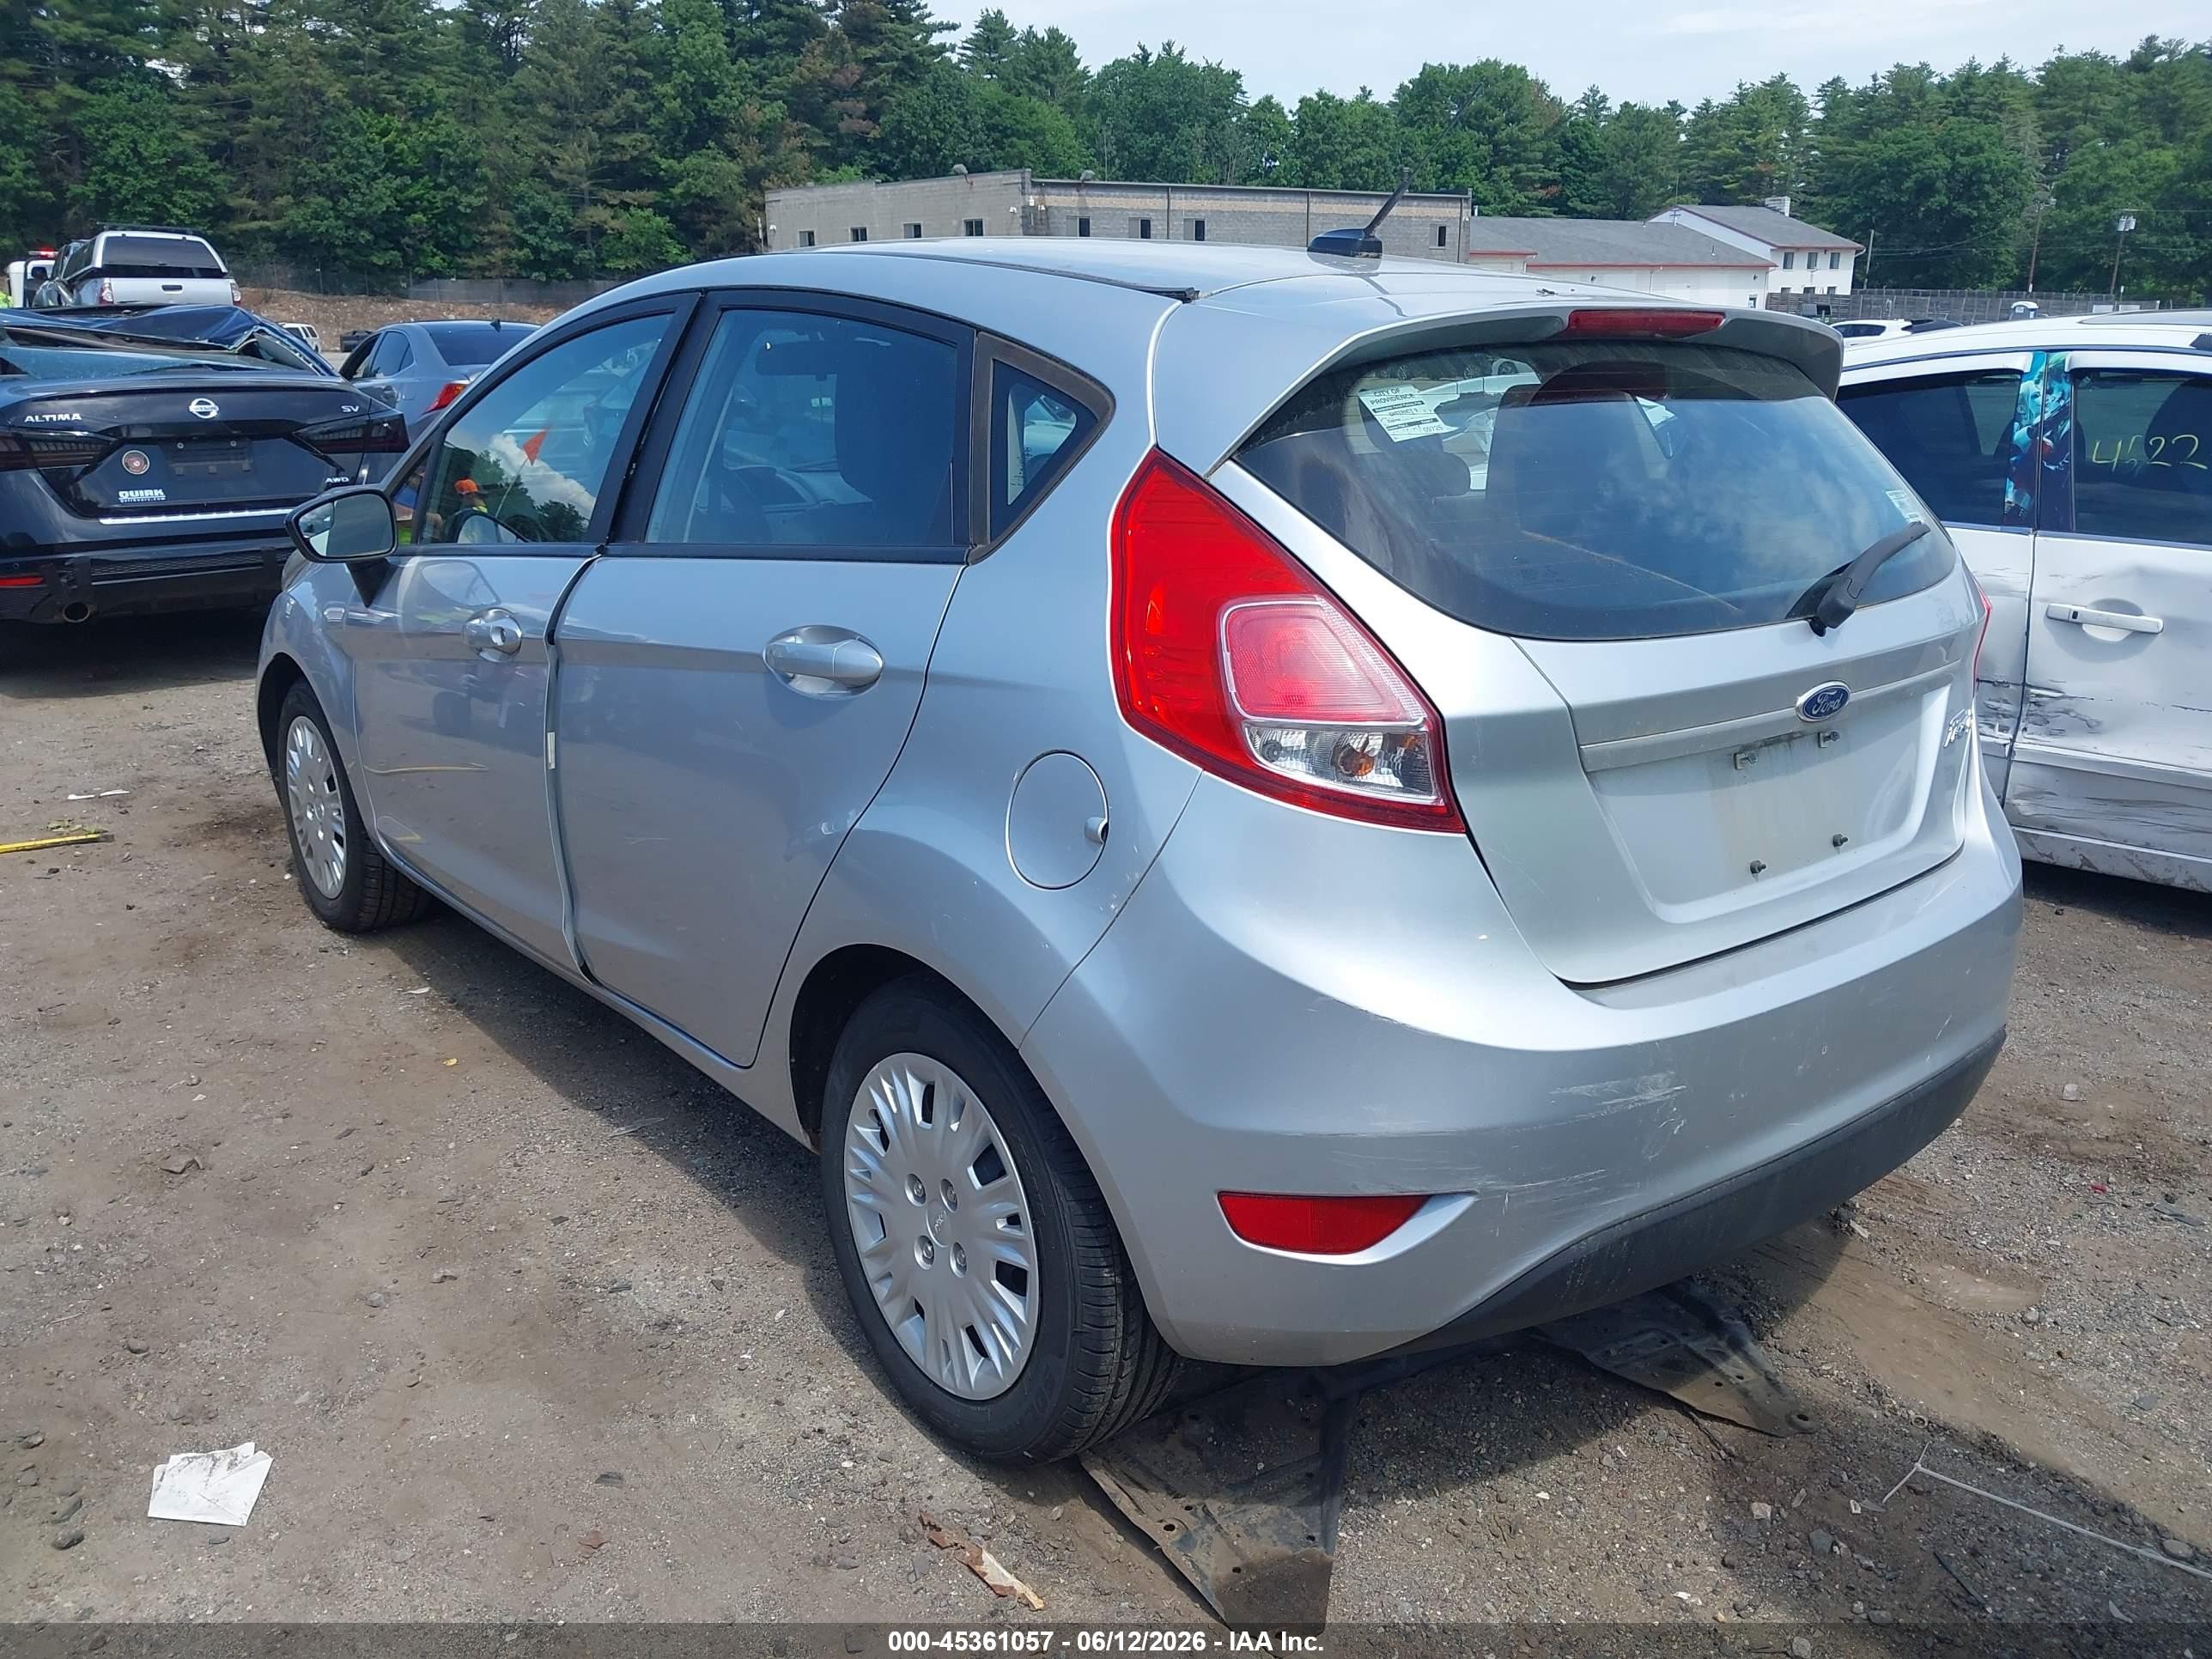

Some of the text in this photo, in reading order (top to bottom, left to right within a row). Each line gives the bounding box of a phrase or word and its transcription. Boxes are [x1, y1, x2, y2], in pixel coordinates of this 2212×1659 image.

[1370, 393, 1416, 406] PROVIDENCE
[24, 413, 82, 422] ALTIMA
[118, 489, 164, 498] QUIRK
[1811, 690, 1844, 714] Ford
